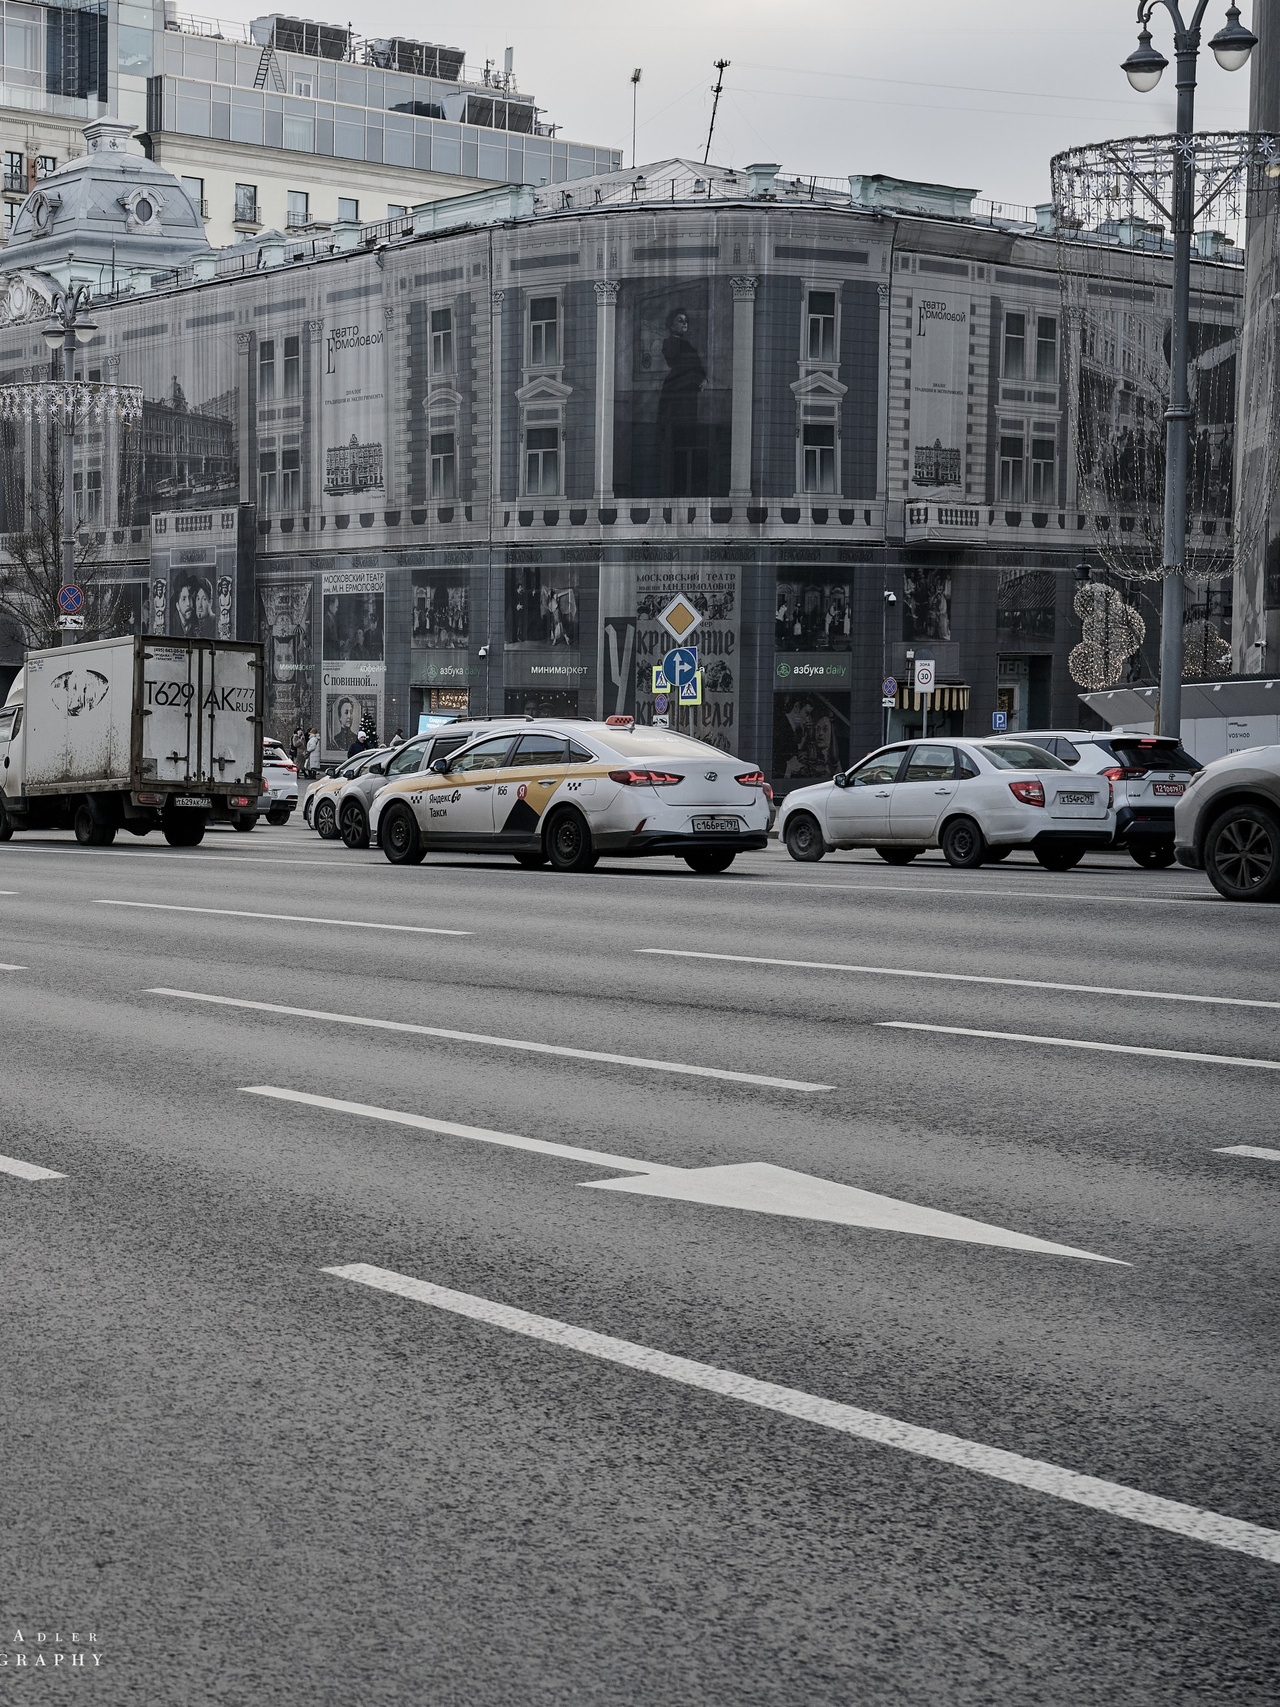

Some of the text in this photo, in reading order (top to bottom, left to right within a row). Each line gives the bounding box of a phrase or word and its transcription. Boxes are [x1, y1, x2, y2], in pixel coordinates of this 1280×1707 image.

[922, 300, 946, 311] театр
[917, 306, 966, 336] Ермоловой
[330, 325, 359, 338] театр
[326, 329, 384, 374] Ермоловой
[324, 572, 384, 584] МОСКОВСКИЙ ТЕАТР
[637, 572, 700, 582] МОСКОВСКИЙ
[346, 582, 384, 592] ЕРМОЛОВОЙ
[440, 666, 464, 677] азбука
[531, 666, 588, 676] минимаркет
[794, 664, 846, 676] азбука daily
[324, 674, 330, 686] С
[145, 681, 194, 706] Т629
[236, 688, 255, 698] 777
[236, 702, 254, 712] RUS
[498, 786, 508, 796] 166
[429, 790, 462, 804] Яндекс Go
[430, 808, 447, 818] Такси
[696, 820, 736, 830] С166РЕ 797
